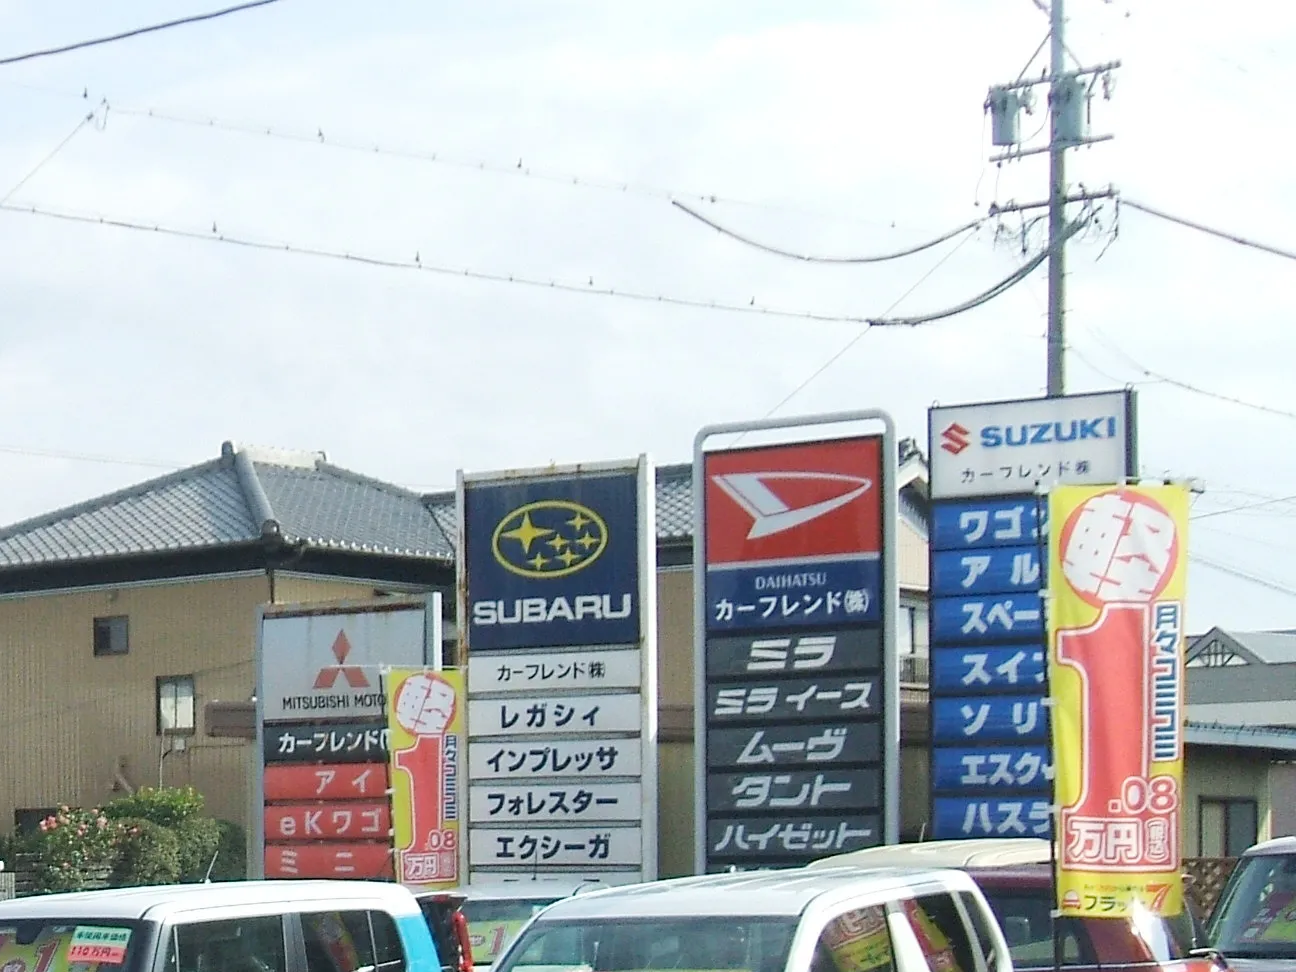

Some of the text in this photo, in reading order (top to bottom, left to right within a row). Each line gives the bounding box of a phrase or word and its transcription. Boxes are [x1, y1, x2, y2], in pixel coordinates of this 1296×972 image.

[980, 416, 1117, 449] SUZUKI
[755, 572, 828, 590] DAIHATSU
[473, 593, 632, 626] SUBARU
[747, 636, 837, 670] ミラ
[1154, 603, 1179, 760] 月々コミコミ
[283, 695, 350, 710] MITSUBISHI
[486, 747, 619, 773] インプレッサ
[736, 728, 848, 764] ムーヴ
[315, 769, 372, 793] アイ
[732, 774, 851, 808] タント
[487, 789, 619, 816] フォレスター
[495, 834, 612, 860] エクシーガ
[714, 822, 872, 851] ハイゼット
[1068, 819, 1140, 862] 万円
[405, 853, 439, 879] 万円
